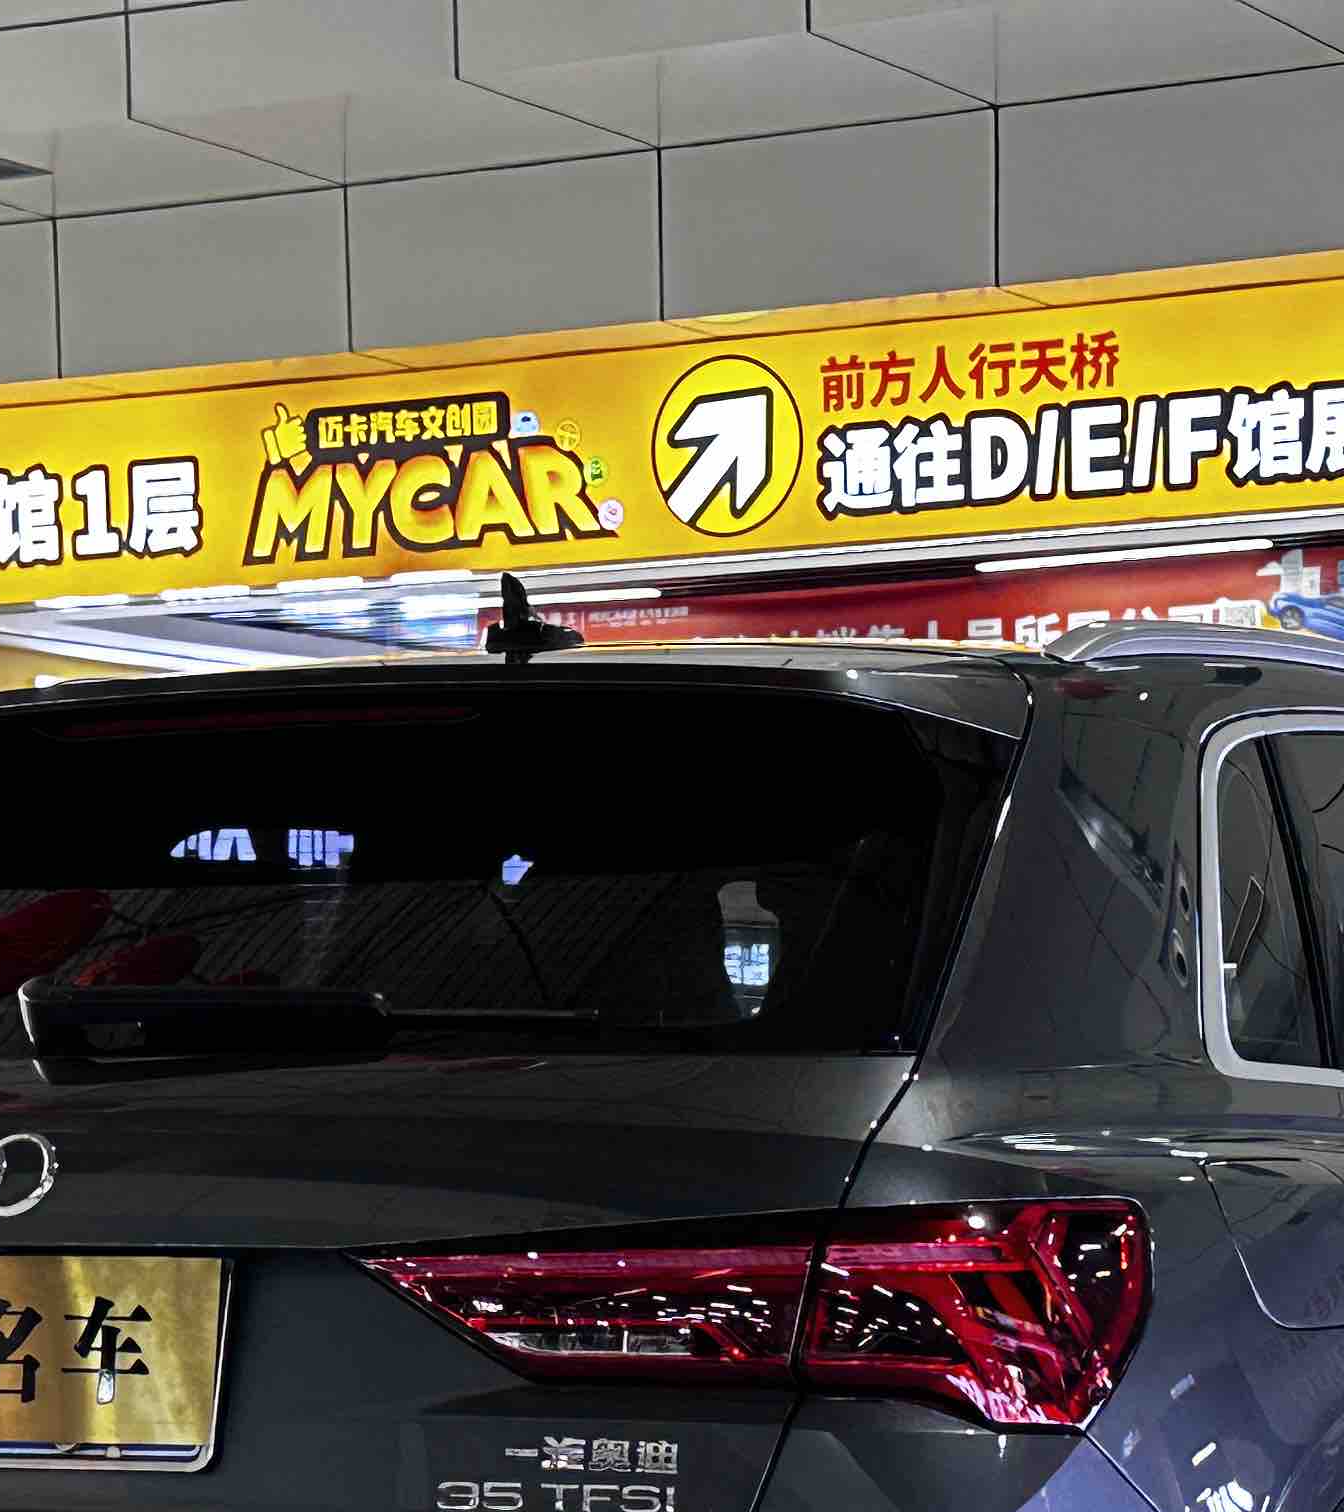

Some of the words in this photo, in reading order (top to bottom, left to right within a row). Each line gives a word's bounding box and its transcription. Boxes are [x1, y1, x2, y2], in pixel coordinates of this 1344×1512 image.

[820, 331, 1120, 413] 前方人行天桥
[317, 400, 499, 447] 迈卡汽车文创园
[249, 443, 608, 562] MYCAR
[505, 1437, 679, 1475] 一汽奥迪
[437, 1481, 523, 1511] 35
